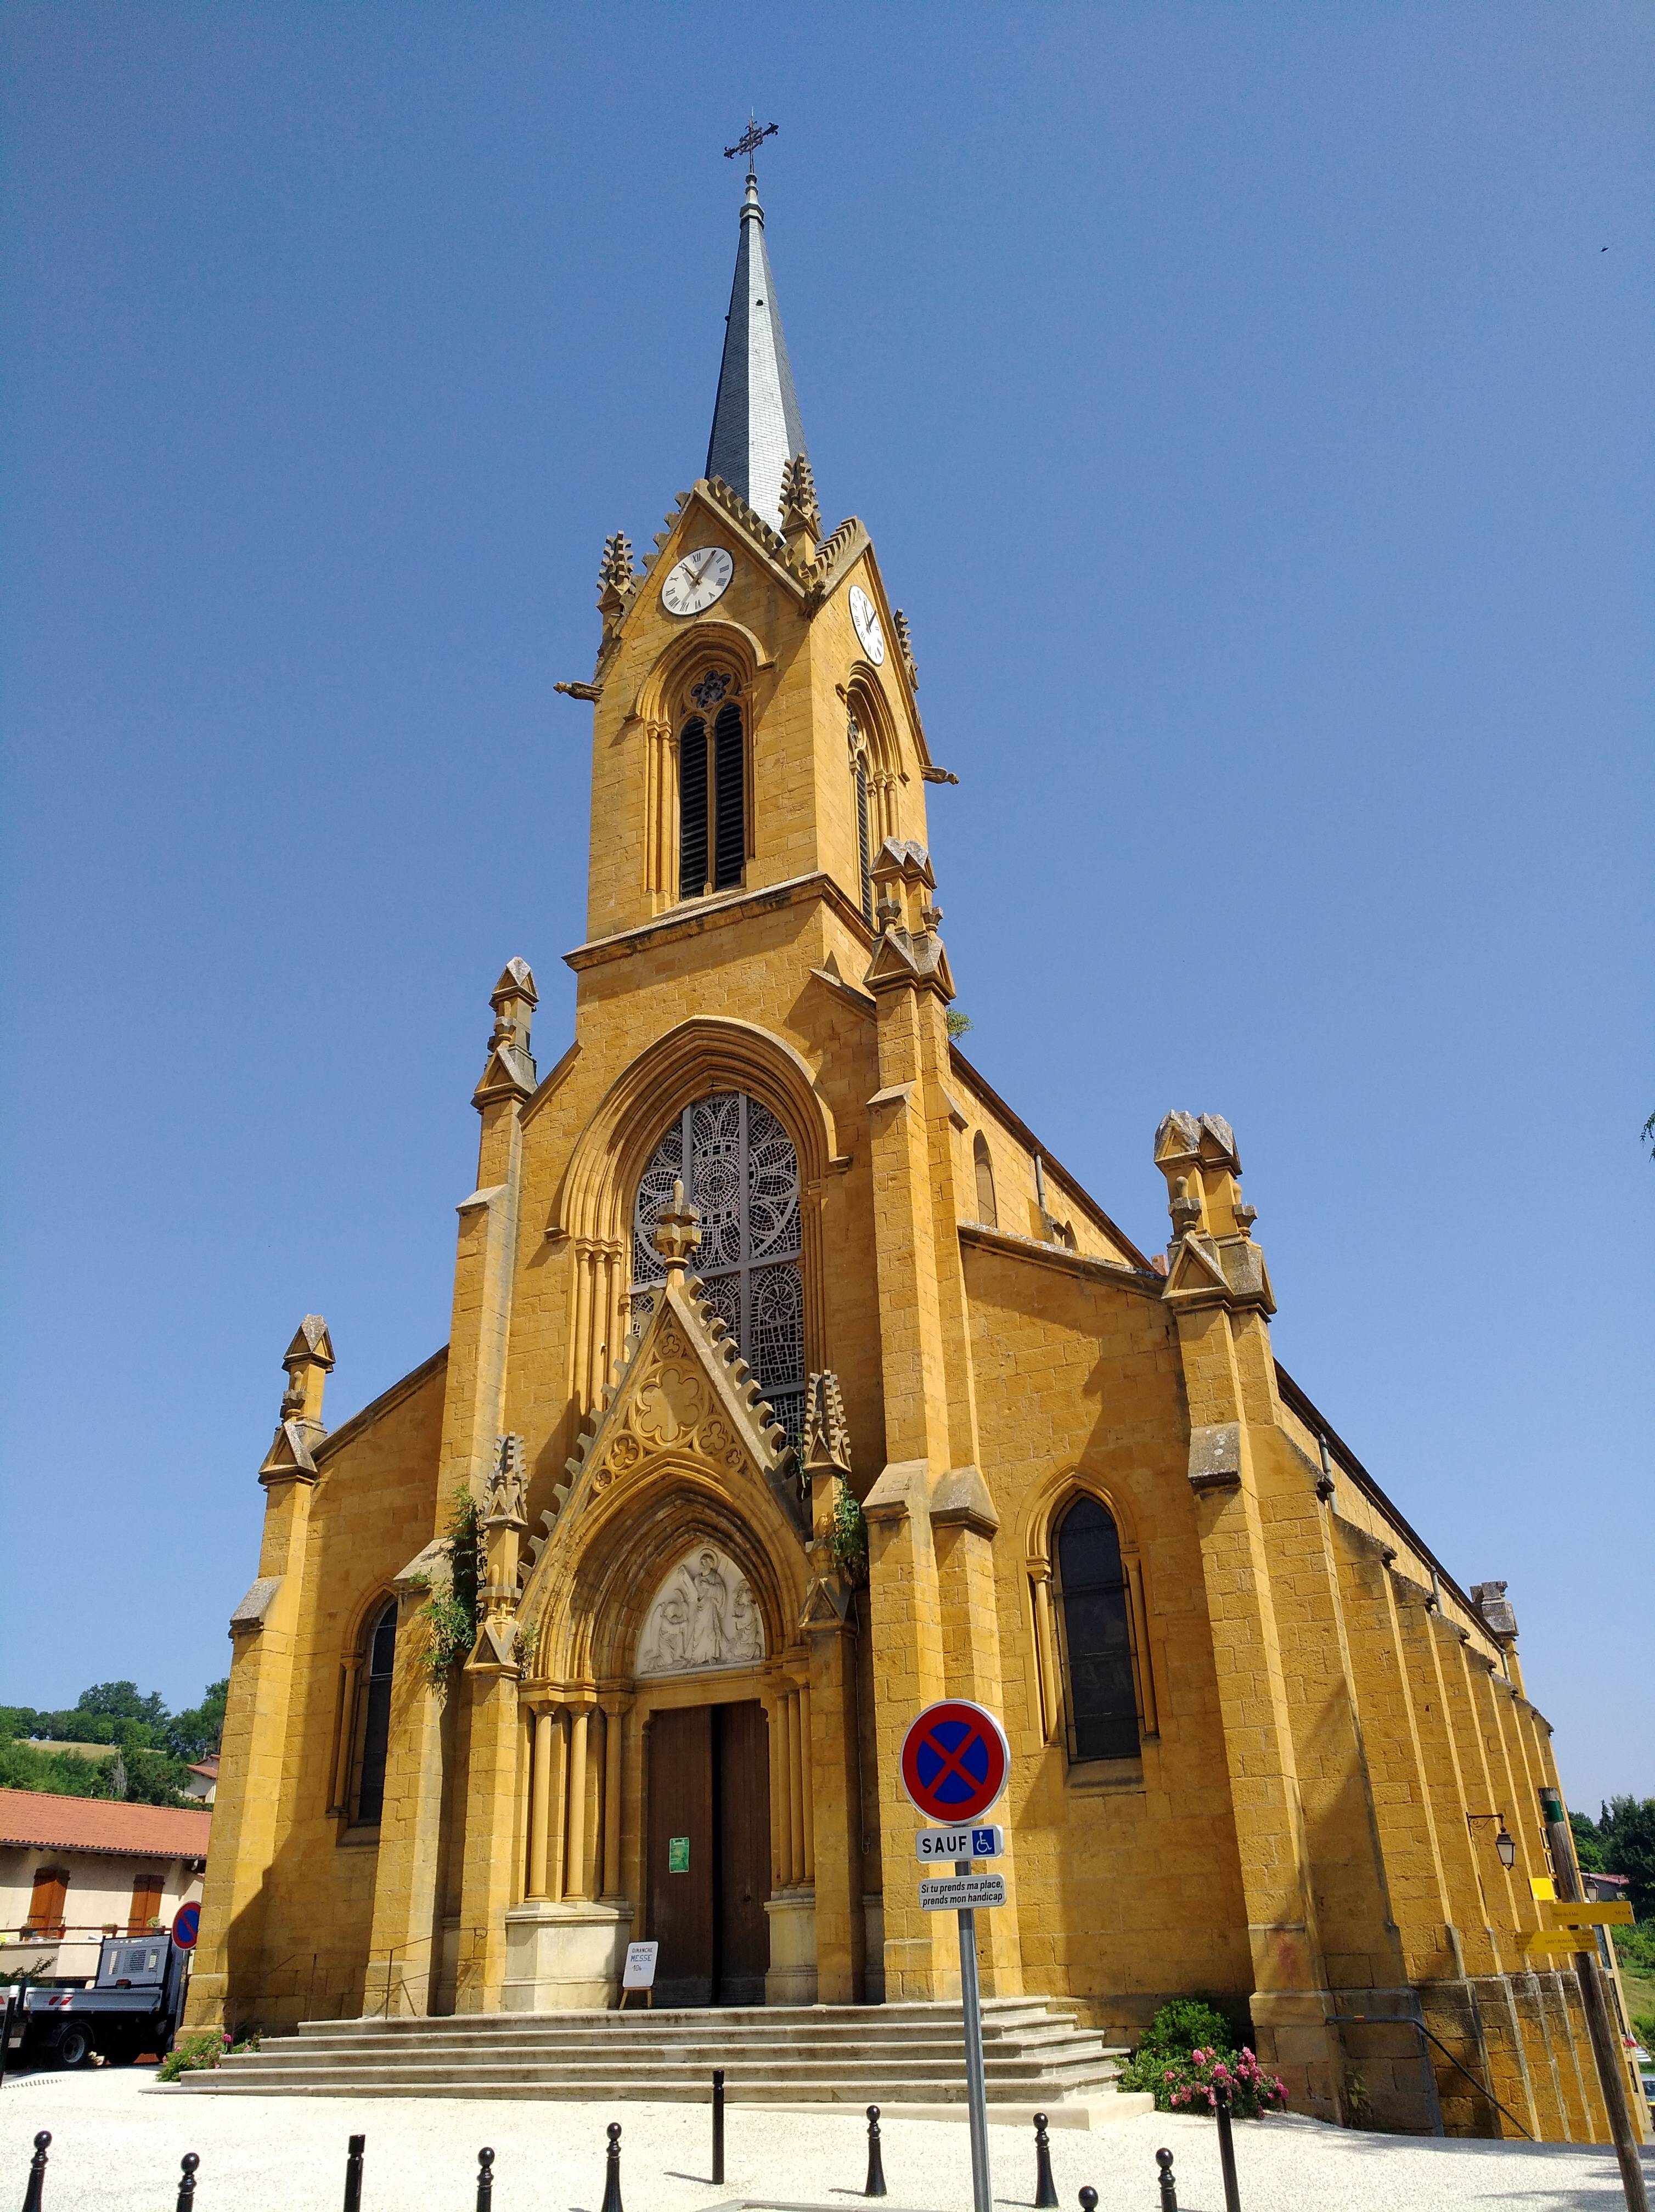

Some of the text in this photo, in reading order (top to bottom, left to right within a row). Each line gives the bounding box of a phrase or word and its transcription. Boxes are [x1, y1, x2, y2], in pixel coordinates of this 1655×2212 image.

[693, 552, 701, 563] XII
[716, 554, 725, 563] II
[719, 565, 729, 573] III
[716, 578, 727, 586] IIII
[708, 592, 716, 600] V
[668, 596, 680, 609] VIII
[695, 600, 701, 610] VI
[922, 1836, 967, 1854] SAUF
[921, 1884, 928, 1893] Si
[939, 1882, 965, 1894] prends
[980, 1880, 1003, 1892] place,
[922, 1892, 1003, 1908] prends mon handicap
